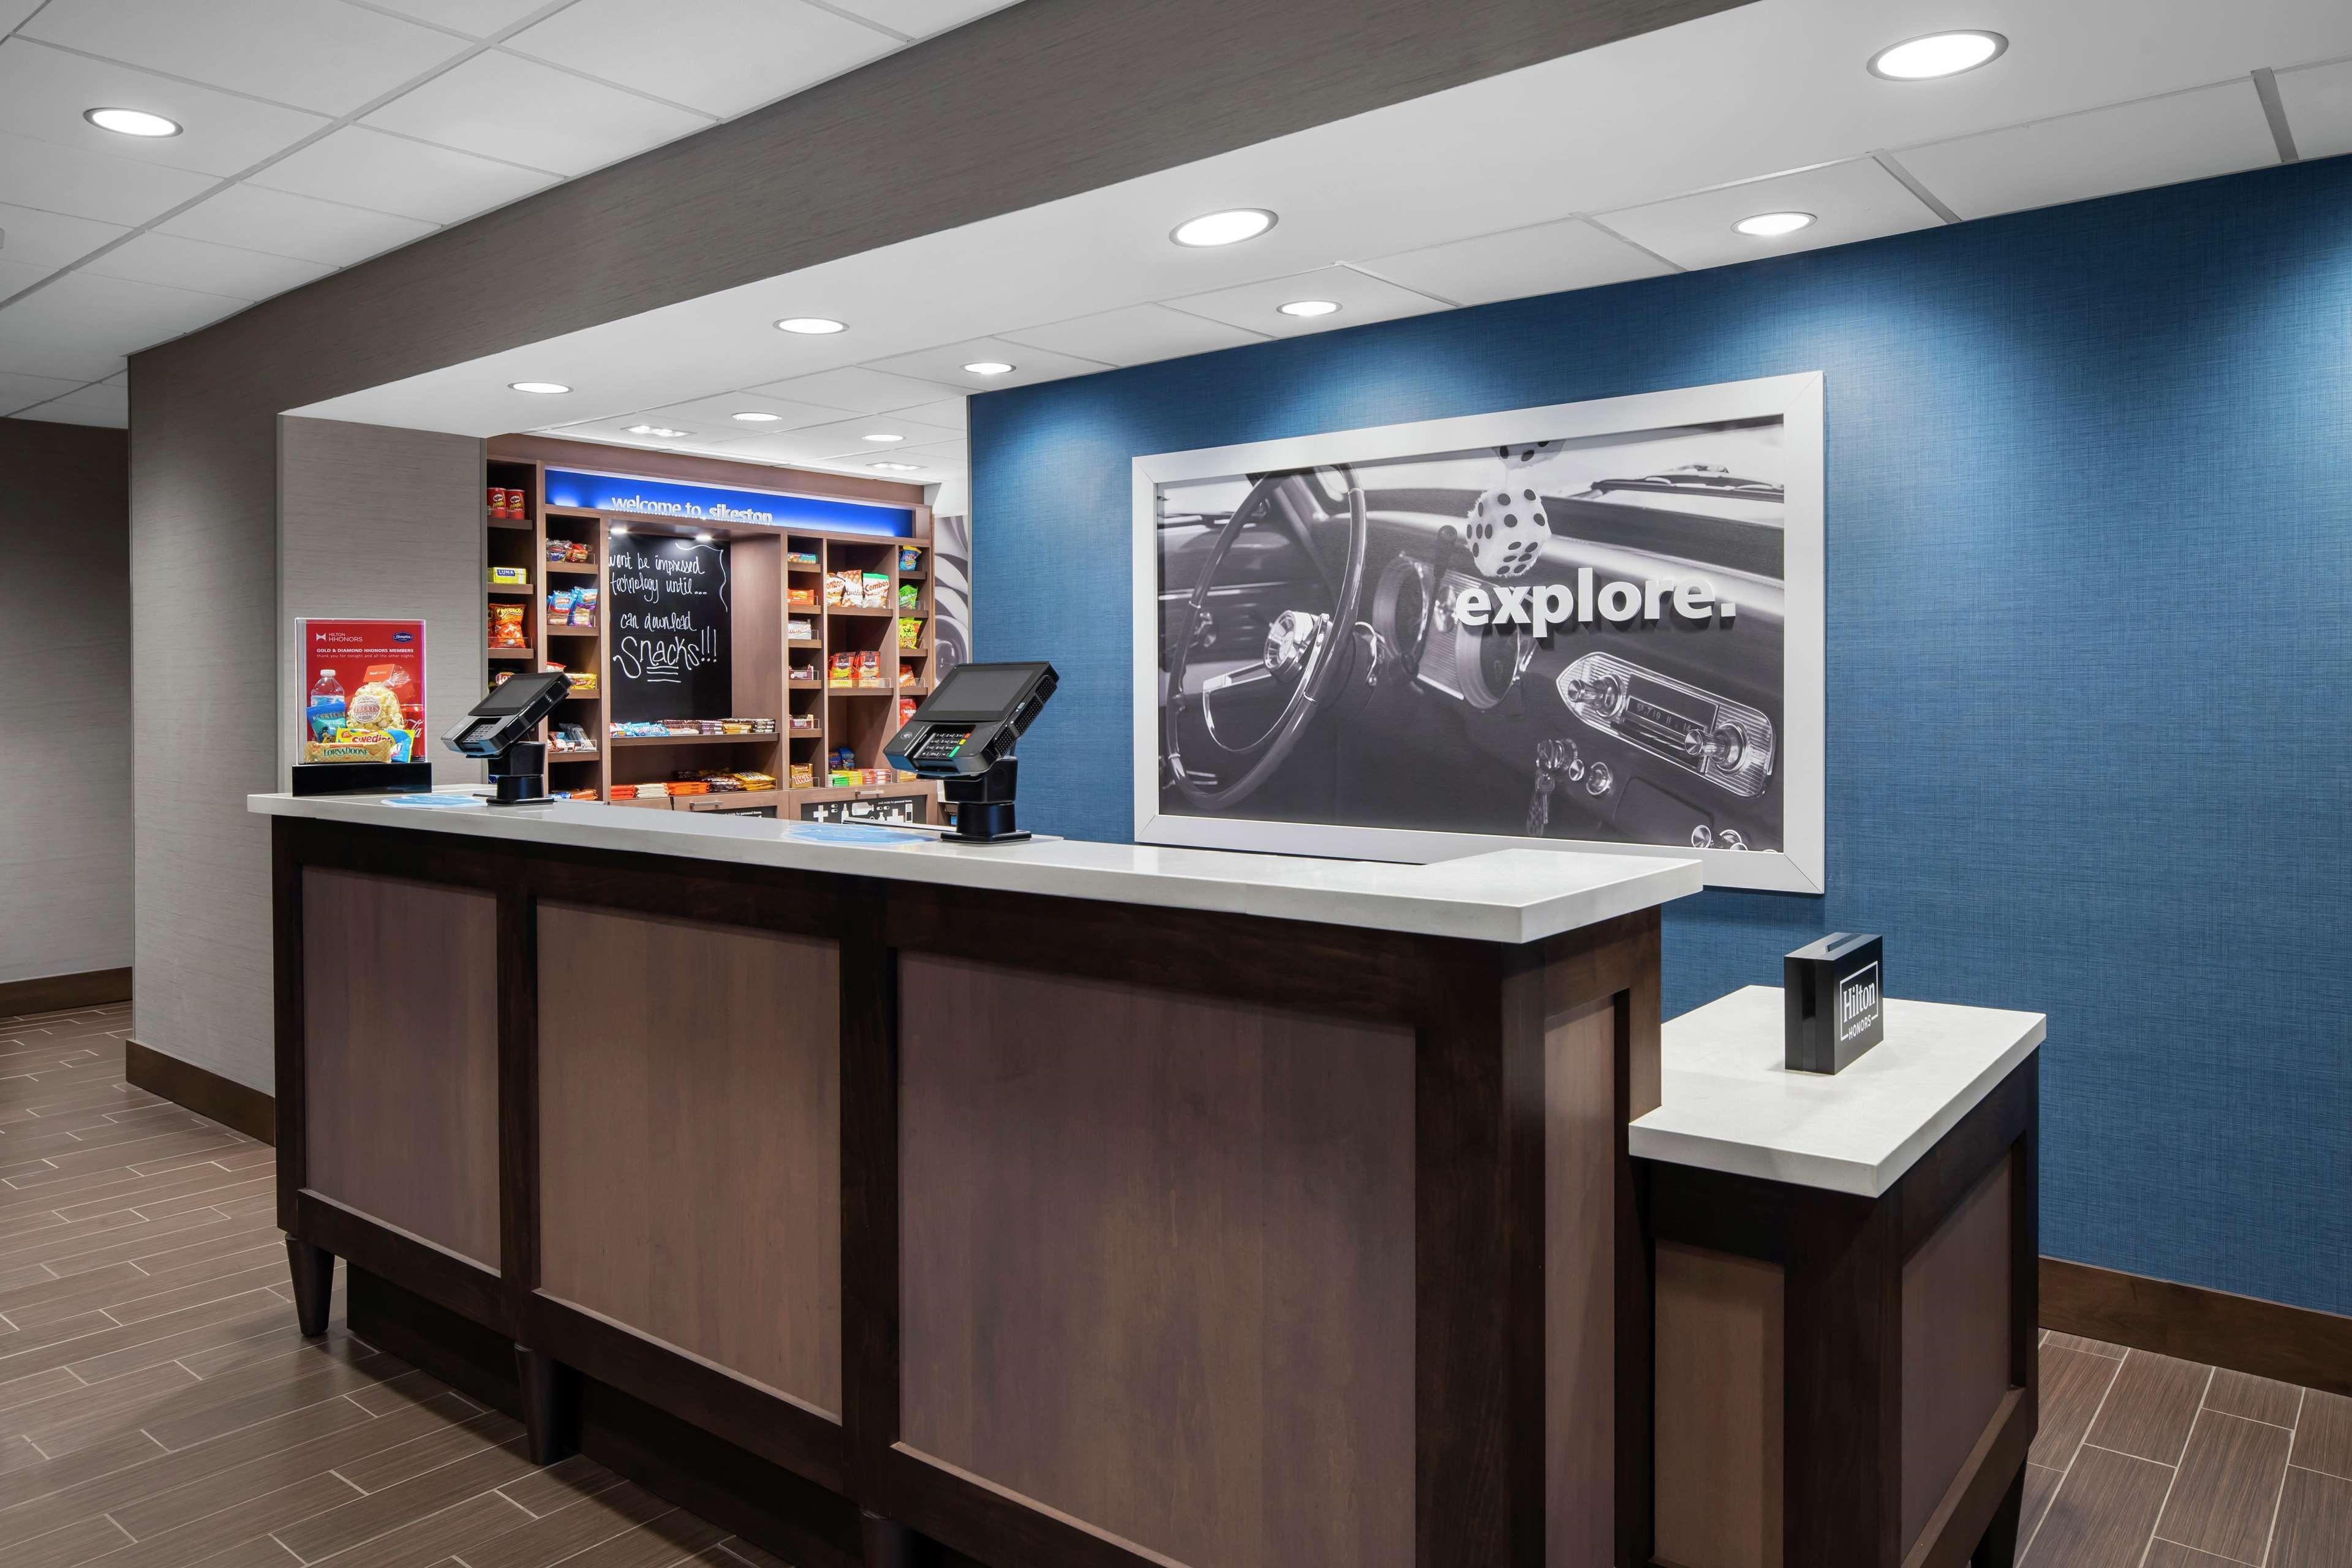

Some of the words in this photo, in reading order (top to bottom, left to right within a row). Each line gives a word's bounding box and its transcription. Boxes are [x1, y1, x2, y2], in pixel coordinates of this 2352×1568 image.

[611, 495, 681, 513] welcome
[685, 502, 701, 516] to
[709, 503, 773, 522] sikeston
[638, 552, 650, 570] be
[655, 555, 705, 576] impressed
[610, 571, 659, 603] technology
[827, 579, 843, 589] ombos
[865, 581, 889, 592] Combos
[1455, 567, 1736, 638] explore.
[620, 612, 639, 629] can
[644, 611, 698, 632] download
[1843, 982, 1876, 1023] Hilton
[1849, 1014, 1872, 1040] HONORS
